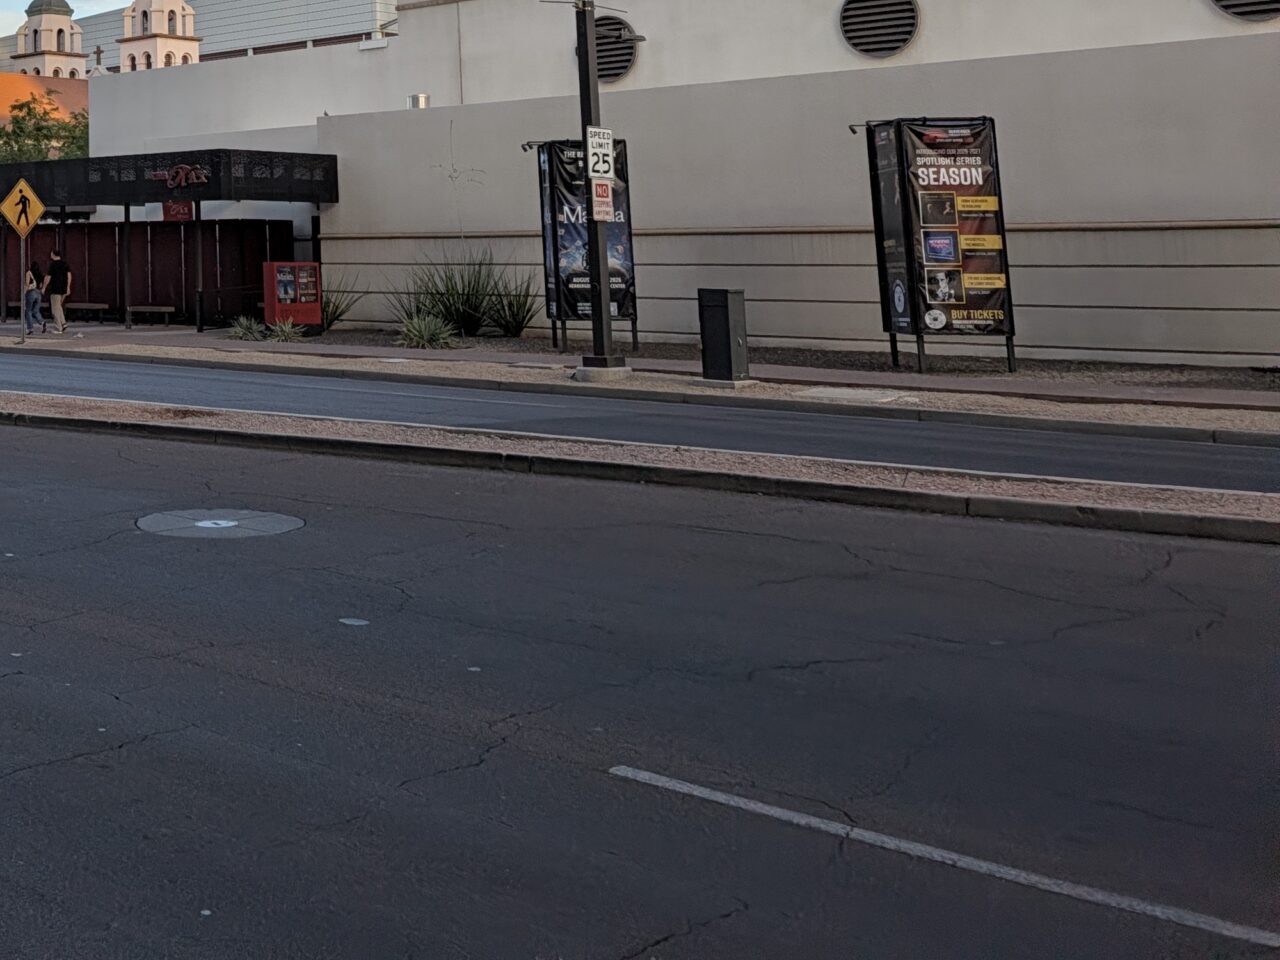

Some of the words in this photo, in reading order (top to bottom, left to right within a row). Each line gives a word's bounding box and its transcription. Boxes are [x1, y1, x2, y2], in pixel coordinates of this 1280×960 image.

[590, 130, 611, 140] SPEED
[592, 142, 610, 150] LIMIT
[592, 152, 611, 174] 25
[917, 157, 955, 166] SPOTLIGHT
[956, 157, 982, 165] SERIES
[918, 168, 984, 186] SEASON
[596, 185, 608, 196] NO
[594, 200, 612, 208] STOPPING
[951, 310, 968, 320] BUY
[970, 310, 1005, 320] TICKETS
